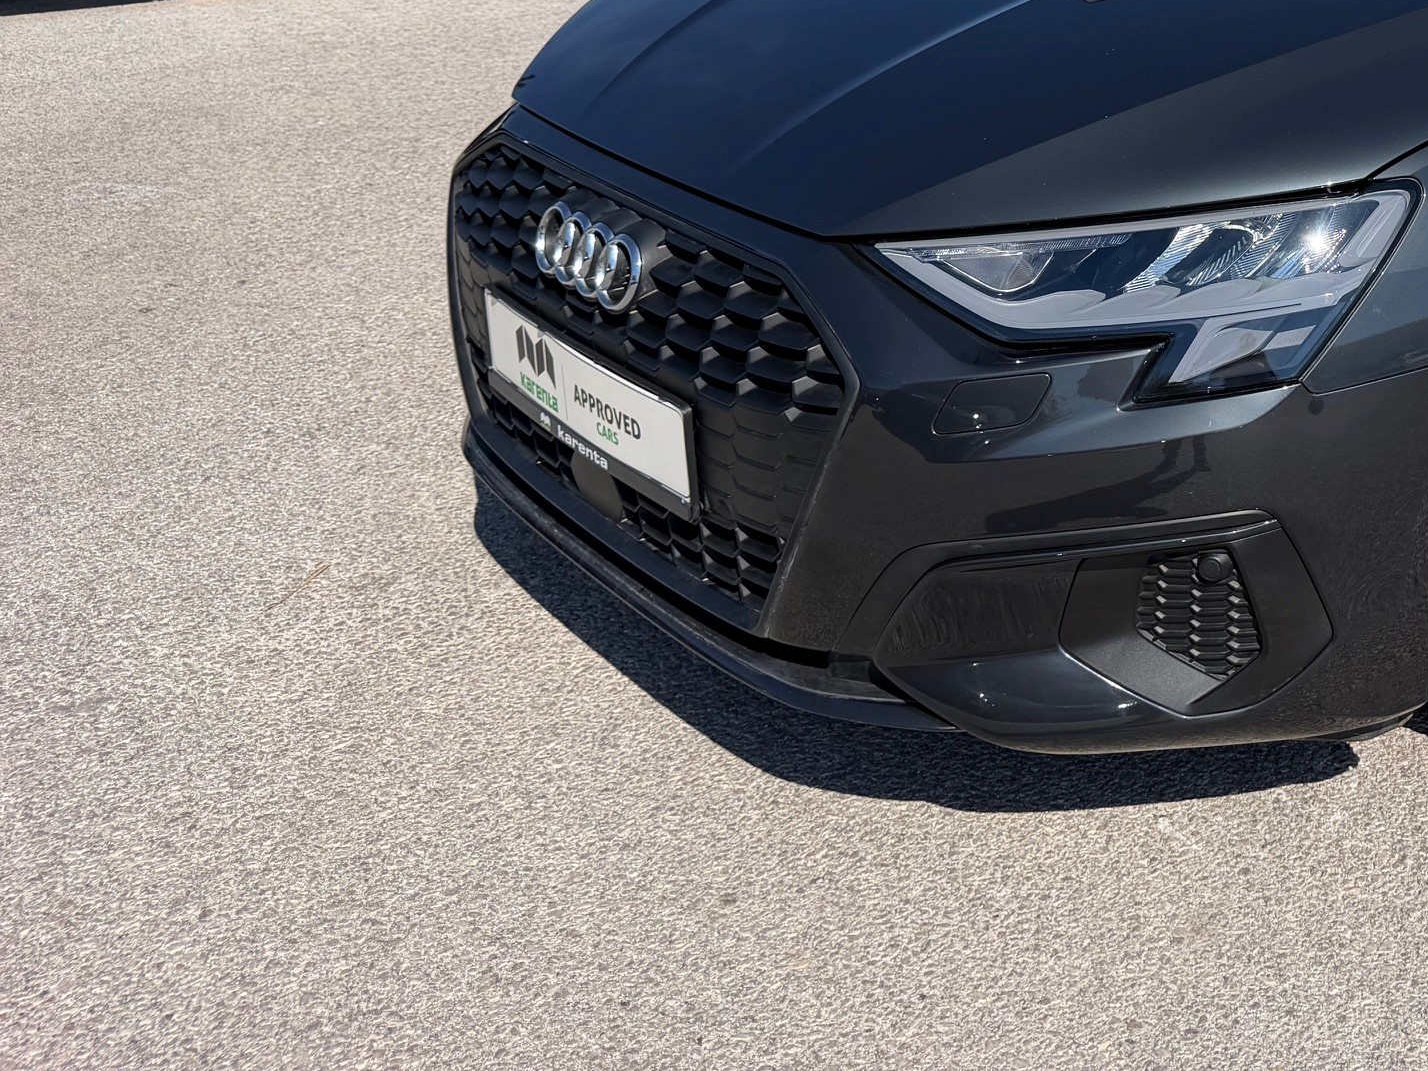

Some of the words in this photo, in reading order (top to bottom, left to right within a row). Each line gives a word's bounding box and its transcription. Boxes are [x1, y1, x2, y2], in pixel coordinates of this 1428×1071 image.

[520, 371, 559, 413] karenta
[573, 384, 642, 440] APPROVED
[557, 424, 609, 471] karenta
[596, 422, 619, 446] CARS
